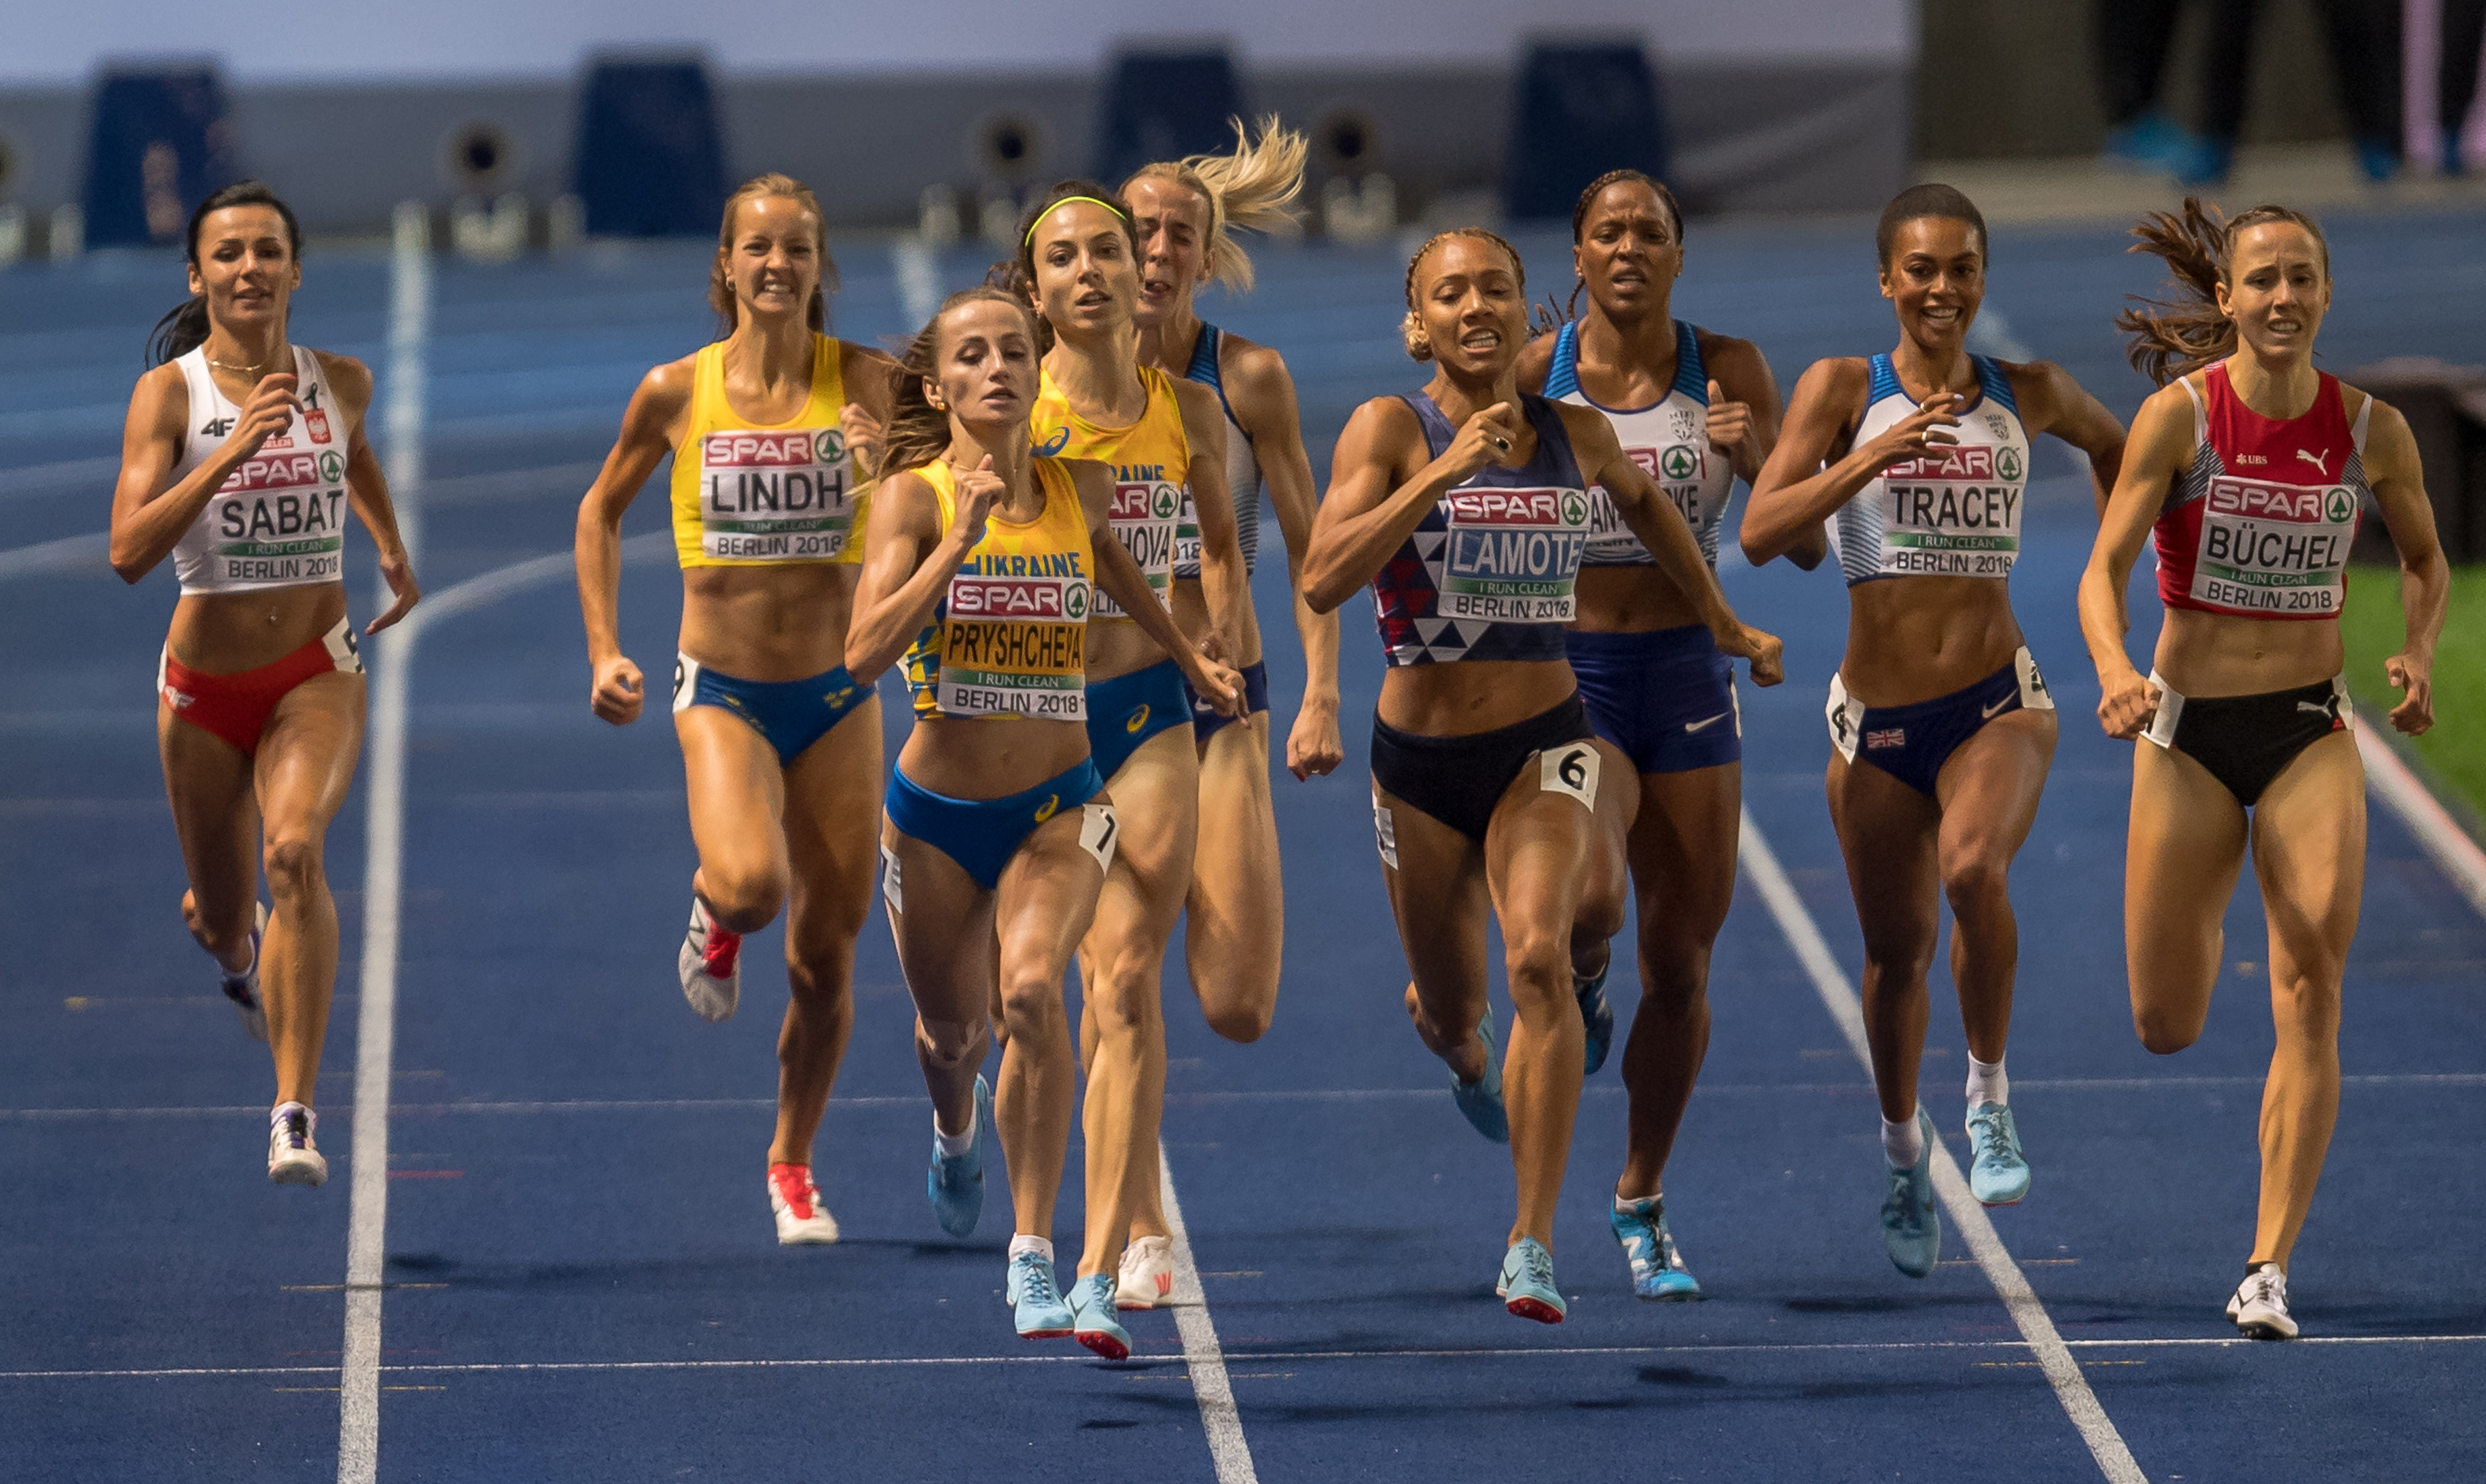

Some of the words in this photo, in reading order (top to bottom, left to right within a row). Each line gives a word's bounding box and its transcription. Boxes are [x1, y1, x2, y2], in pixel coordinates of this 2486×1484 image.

[708, 437, 810, 463] SPAR
[2248, 455, 2268, 465] UBS
[710, 471, 844, 512] LINDH
[2212, 484, 2320, 518] SPAR
[221, 489, 344, 538] SABAT
[1454, 495, 1557, 520] SPAR
[1890, 486, 2019, 529] TRACEY
[248, 545, 252, 554] I
[255, 544, 283, 555] RUN
[287, 542, 323, 554] CLEAN
[717, 537, 789, 555] BERLIN
[796, 535, 842, 554] 2018
[1452, 531, 1584, 576] LAMOTE
[1917, 535, 1922, 546] I
[1925, 536, 1953, 549] RUN
[1956, 537, 1996, 549] CLEAN
[2207, 522, 2341, 570] BÜCHEL
[228, 559, 300, 578] BERLIN
[306, 556, 338, 577] 2018
[975, 552, 1085, 578] UKRAINE
[1896, 551, 1969, 573] BERLIN
[1975, 556, 2013, 573] 2018
[1479, 582, 1483, 593] I
[1487, 583, 1515, 594] RUN
[1518, 583, 1558, 594] CLEAN
[2236, 573, 2267, 584] RUN
[2271, 574, 2307, 585] CLEAN
[956, 584, 1060, 613] SPAR
[1456, 596, 1530, 619] BERLIN
[1536, 600, 1570, 619] 2018
[2208, 581, 2282, 609] BERLIN
[2287, 590, 2332, 609] 2018
[948, 623, 1081, 669] PRYSHCHEPA
[978, 672, 982, 683] I
[986, 673, 1015, 687] RUN
[1017, 675, 1059, 688] CLEAN
[955, 688, 1031, 712] BERLIN
[1037, 694, 1078, 714] 2018
[1558, 749, 1588, 791] 6
[1096, 808, 1116, 853] 7
